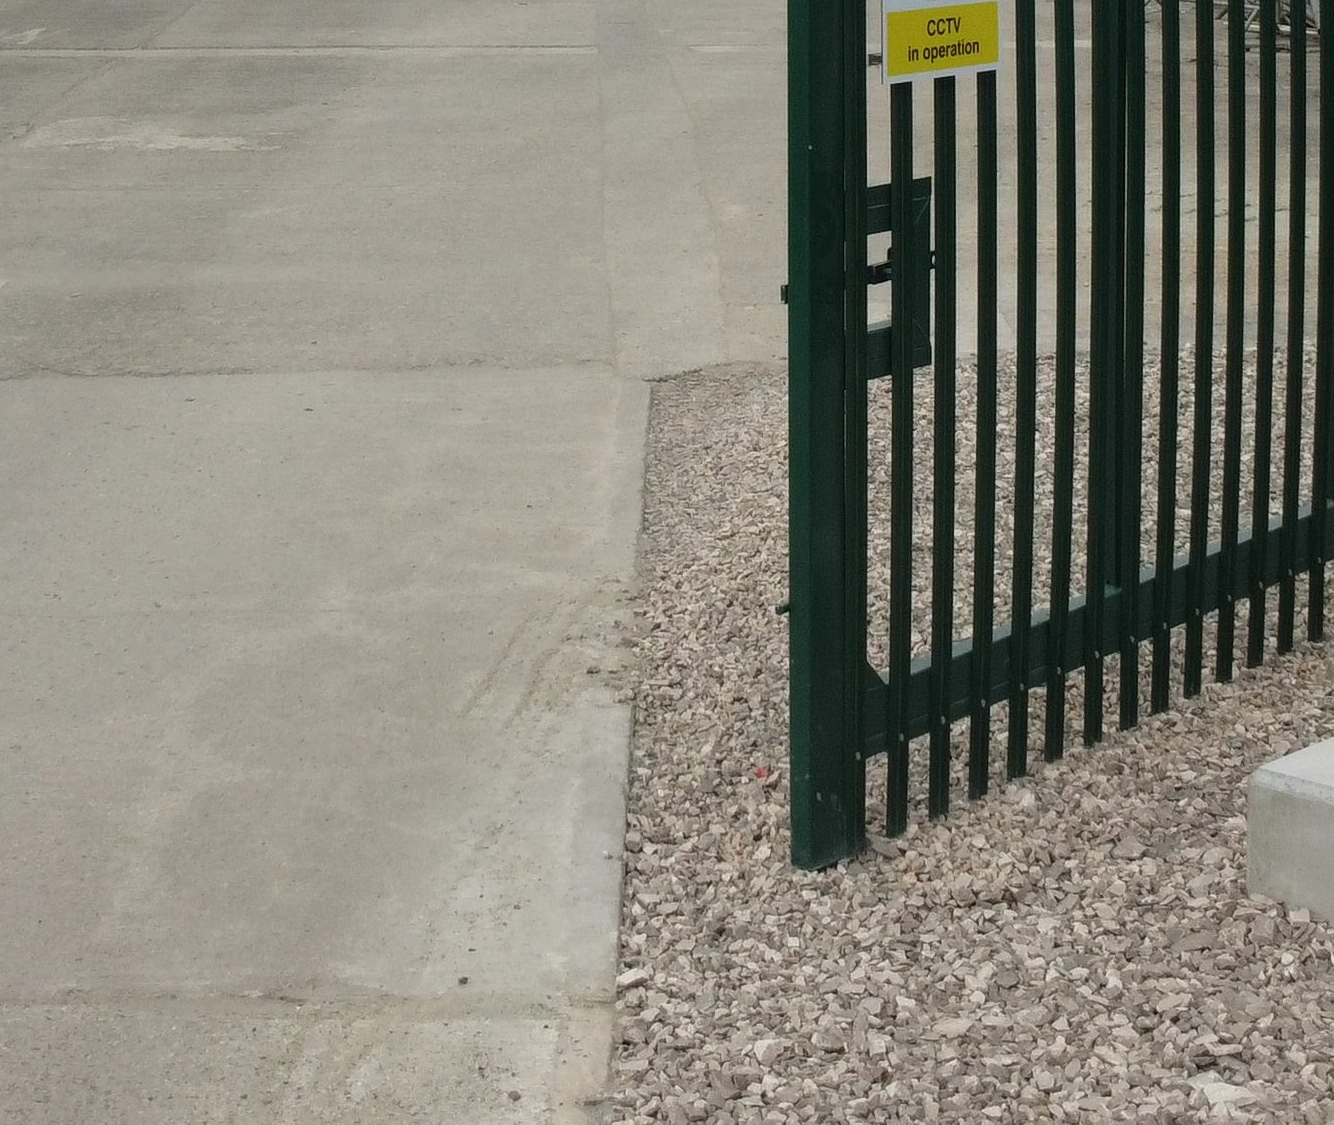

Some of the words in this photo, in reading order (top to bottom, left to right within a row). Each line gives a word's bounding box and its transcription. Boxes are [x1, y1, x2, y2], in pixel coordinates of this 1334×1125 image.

[926, 17, 961, 36] CCTV
[908, 45, 919, 62] in
[923, 39, 980, 64] operation
